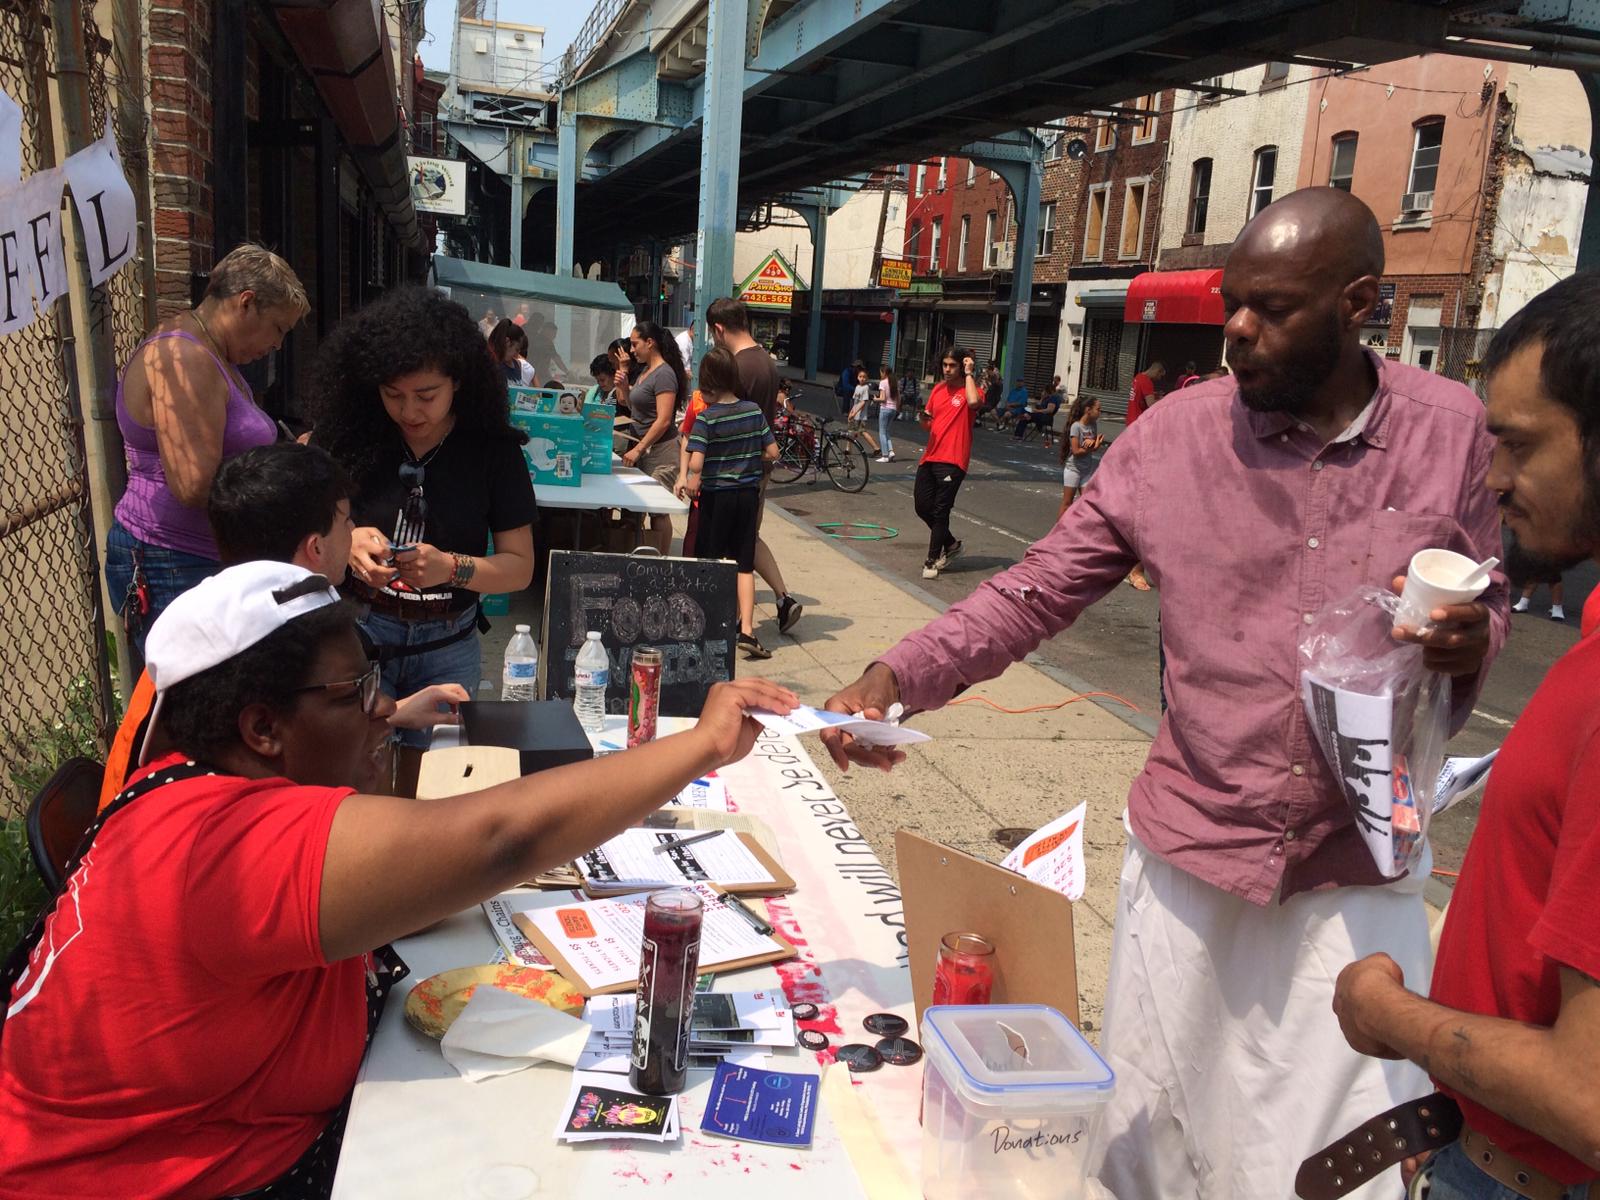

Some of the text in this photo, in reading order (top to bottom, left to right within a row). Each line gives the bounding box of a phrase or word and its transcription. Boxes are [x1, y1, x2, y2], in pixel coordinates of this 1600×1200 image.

[399, 592, 422, 601] PODER
[422, 592, 453, 601] POPULAR
[570, 572, 707, 646] FOOD
[801, 796, 876, 855] never
[695, 884, 728, 911] RAFFLE
[490, 900, 511, 928] Chains
[581, 955, 603, 976] TICKETS
[600, 952, 622, 973] TICKETS
[617, 949, 637, 966] TICKET
[990, 1125, 1082, 1155] Donations
